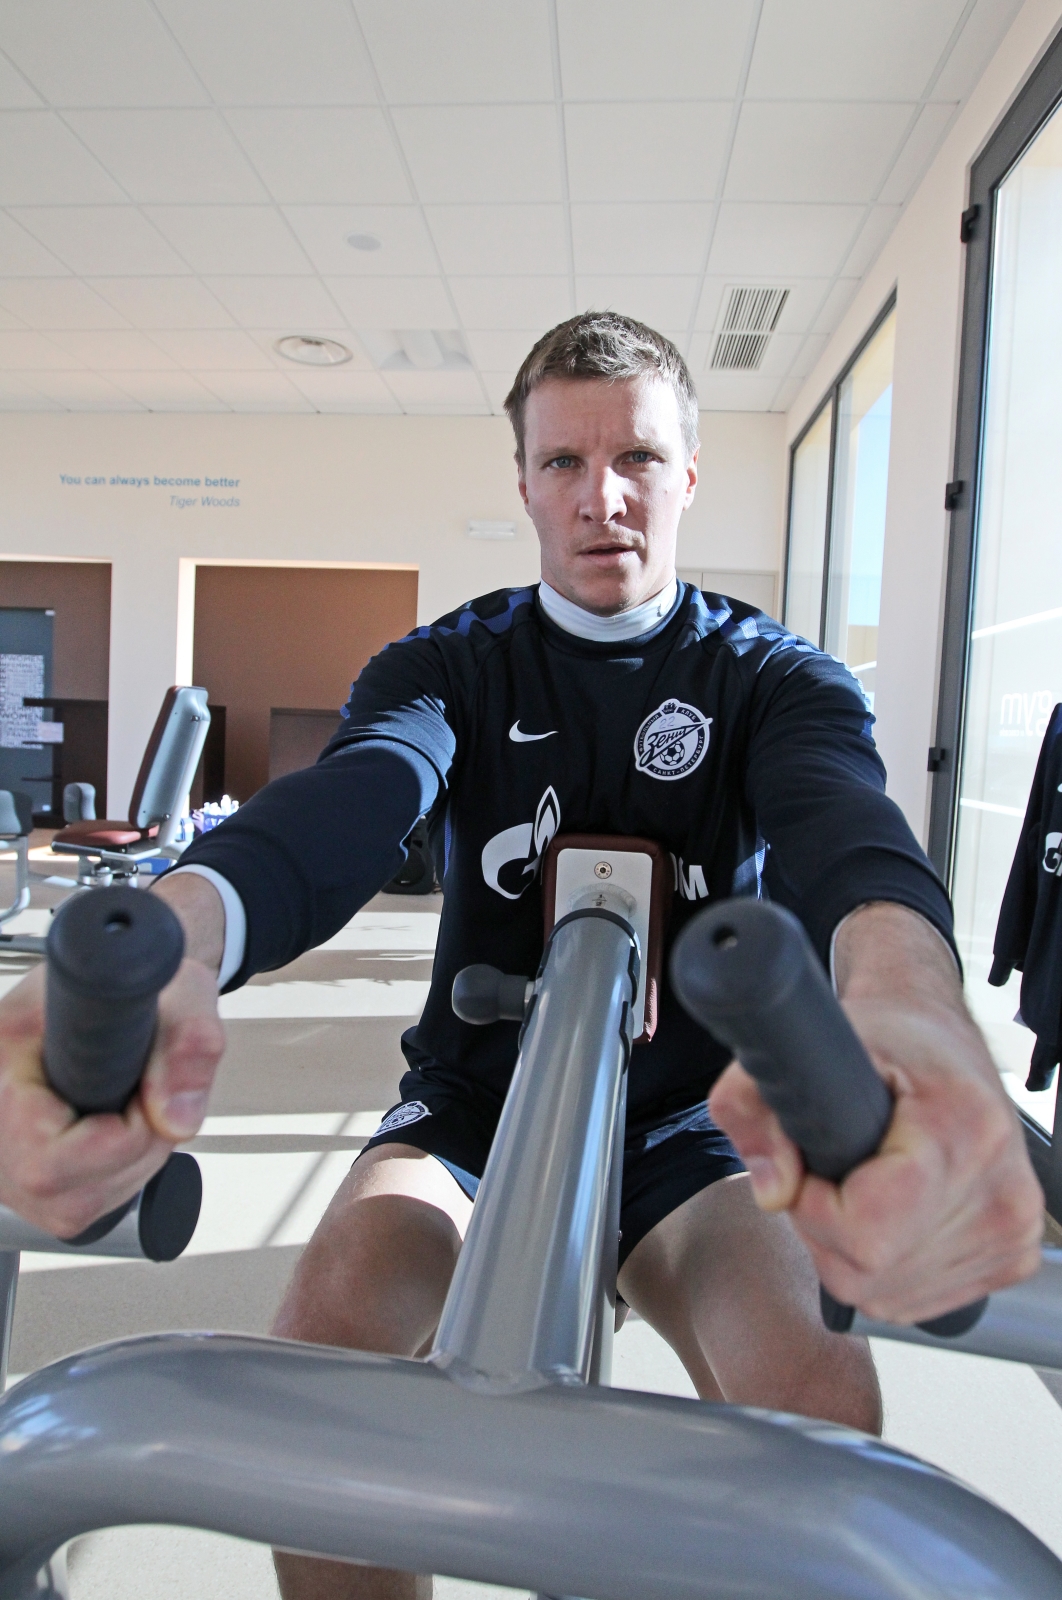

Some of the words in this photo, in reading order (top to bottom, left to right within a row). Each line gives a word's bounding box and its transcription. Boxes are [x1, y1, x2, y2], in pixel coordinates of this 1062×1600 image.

[59, 474, 81, 485] You
[84, 475, 106, 485] can
[109, 475, 150, 488] always
[153, 475, 201, 486] become
[205, 476, 240, 487] better
[170, 495, 198, 508] Tiger
[201, 496, 240, 507] Woods
[681, 708, 697, 721] КЛУБ
[652, 735, 704, 775] САНКТ-ПЕТЕРБУРГ
